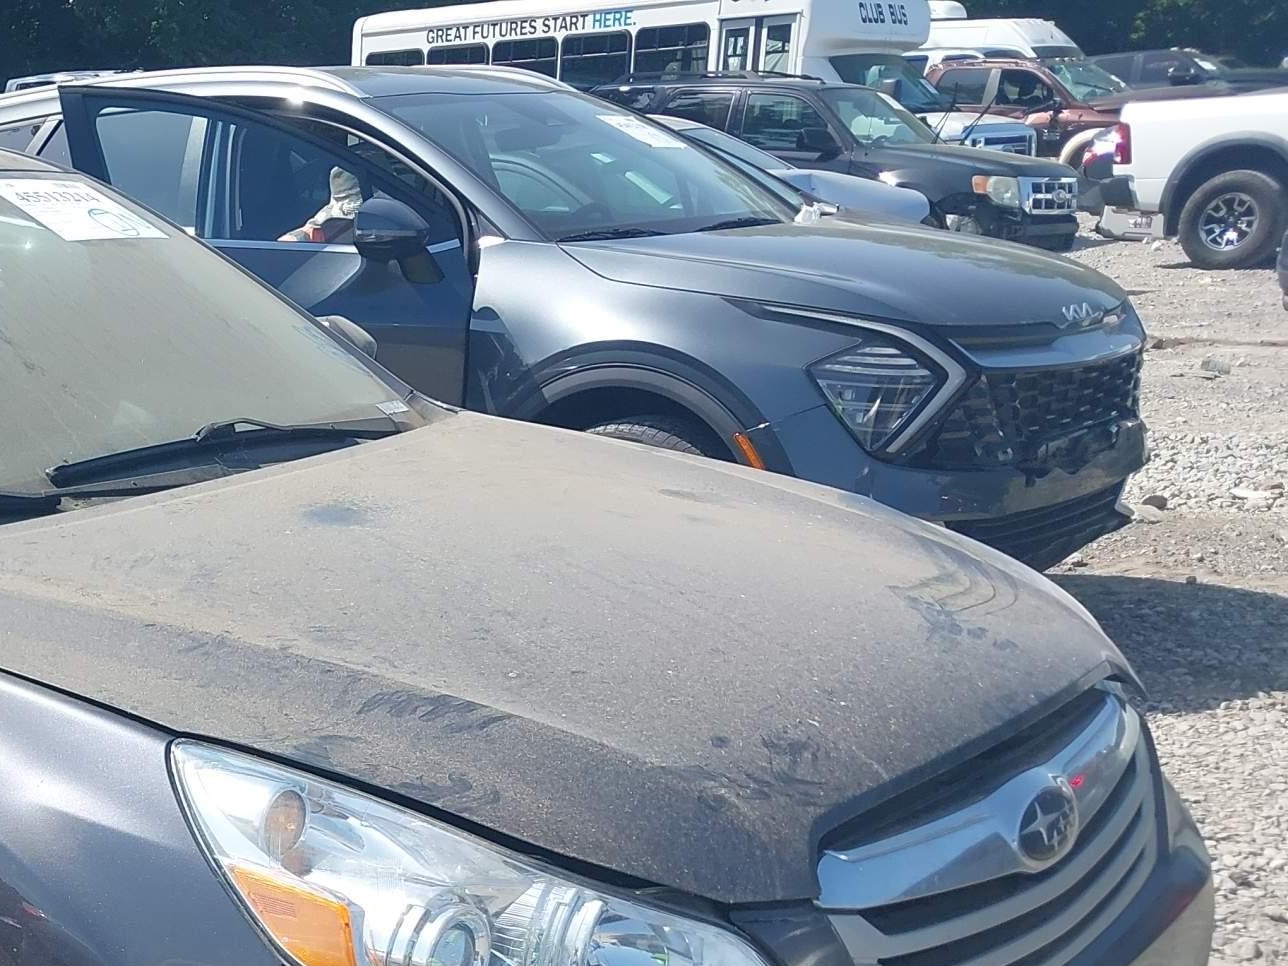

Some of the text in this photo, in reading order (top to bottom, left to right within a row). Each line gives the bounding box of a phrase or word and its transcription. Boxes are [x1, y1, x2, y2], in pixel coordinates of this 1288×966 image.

[426, 10, 637, 44] GREAT FUTURES START HERE.
[858, 2, 909, 26] CLUB BUS
